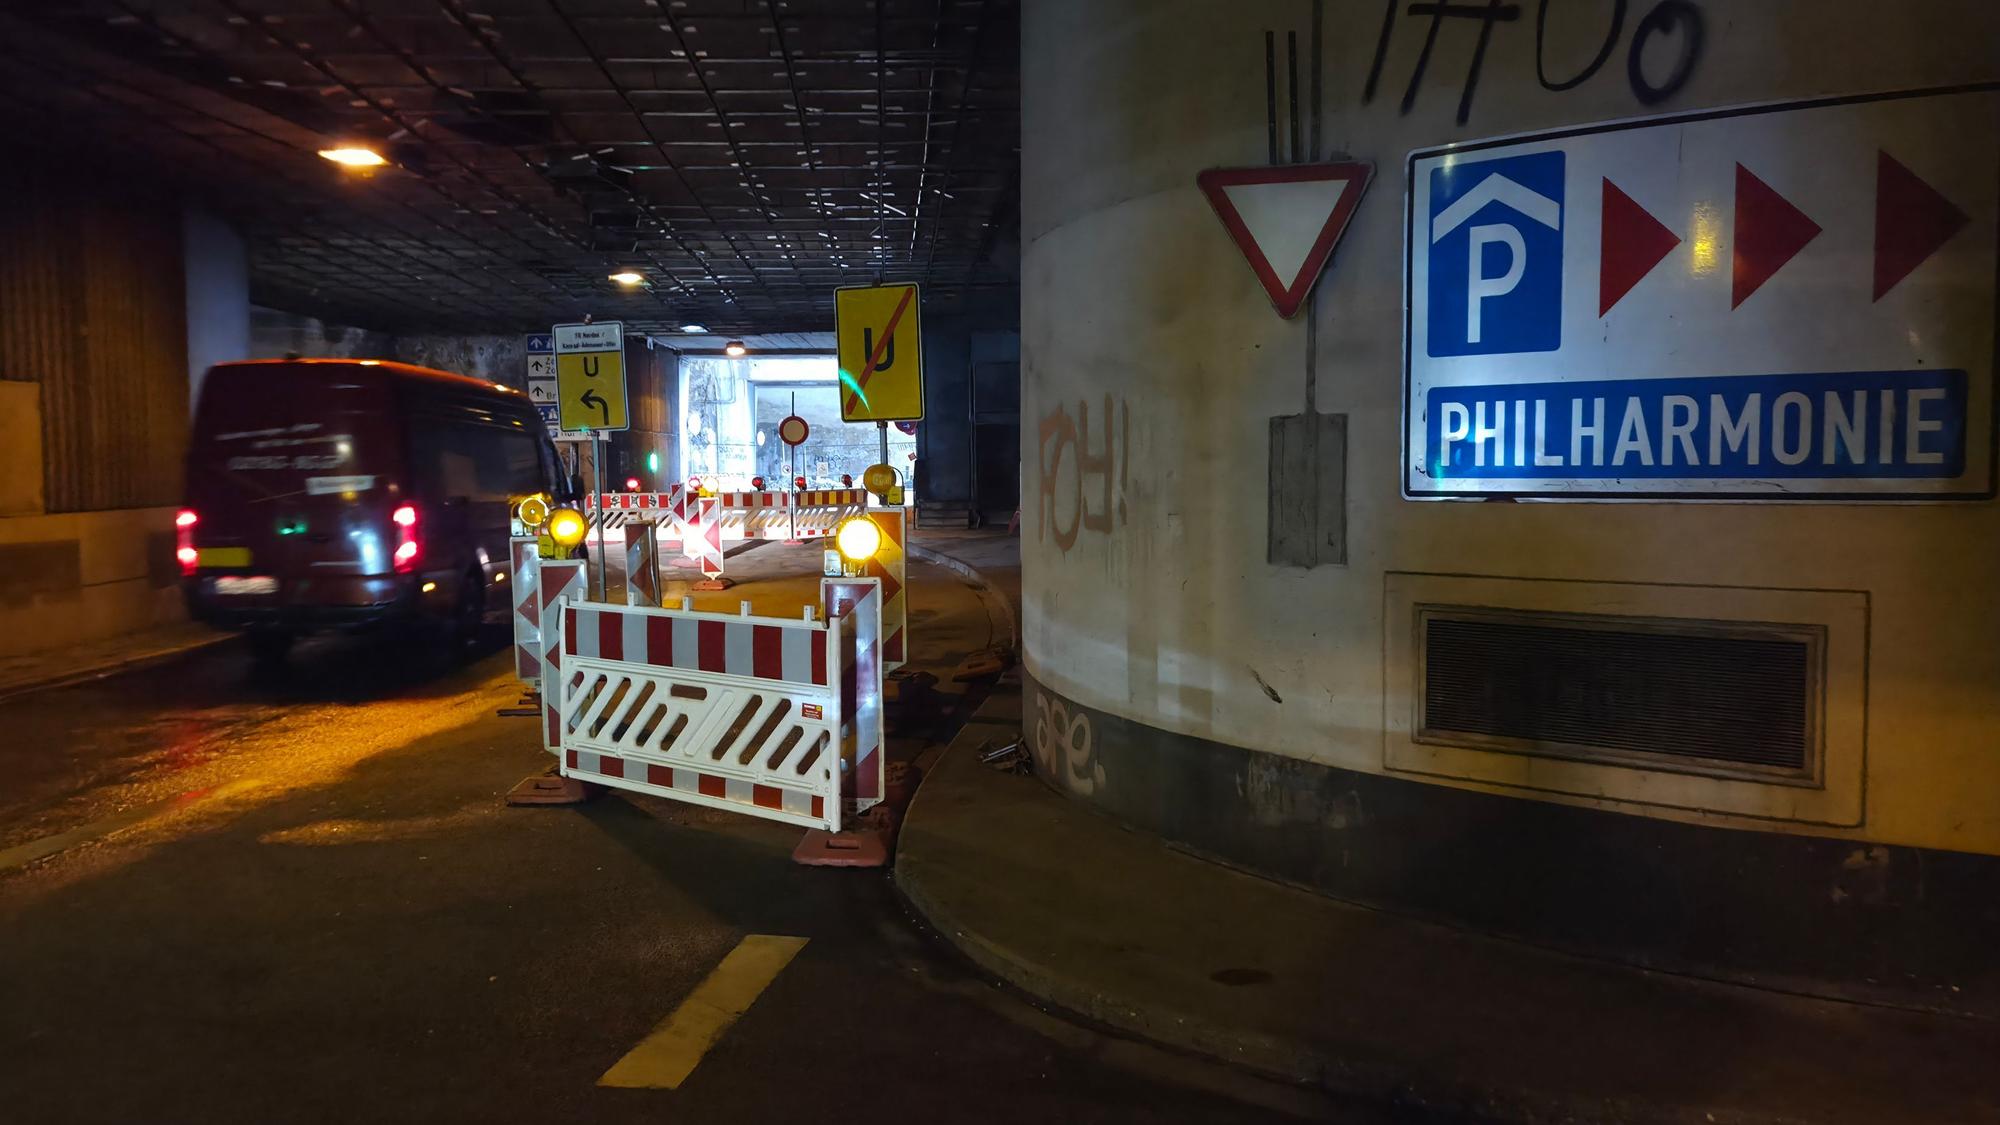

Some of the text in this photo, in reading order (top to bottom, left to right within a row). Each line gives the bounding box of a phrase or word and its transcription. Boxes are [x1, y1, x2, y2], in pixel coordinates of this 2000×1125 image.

[1467, 223, 1527, 344] P
[583, 356, 599, 377] U
[863, 327, 895, 372] U
[1440, 387, 1947, 468] PHILHARMONIE
